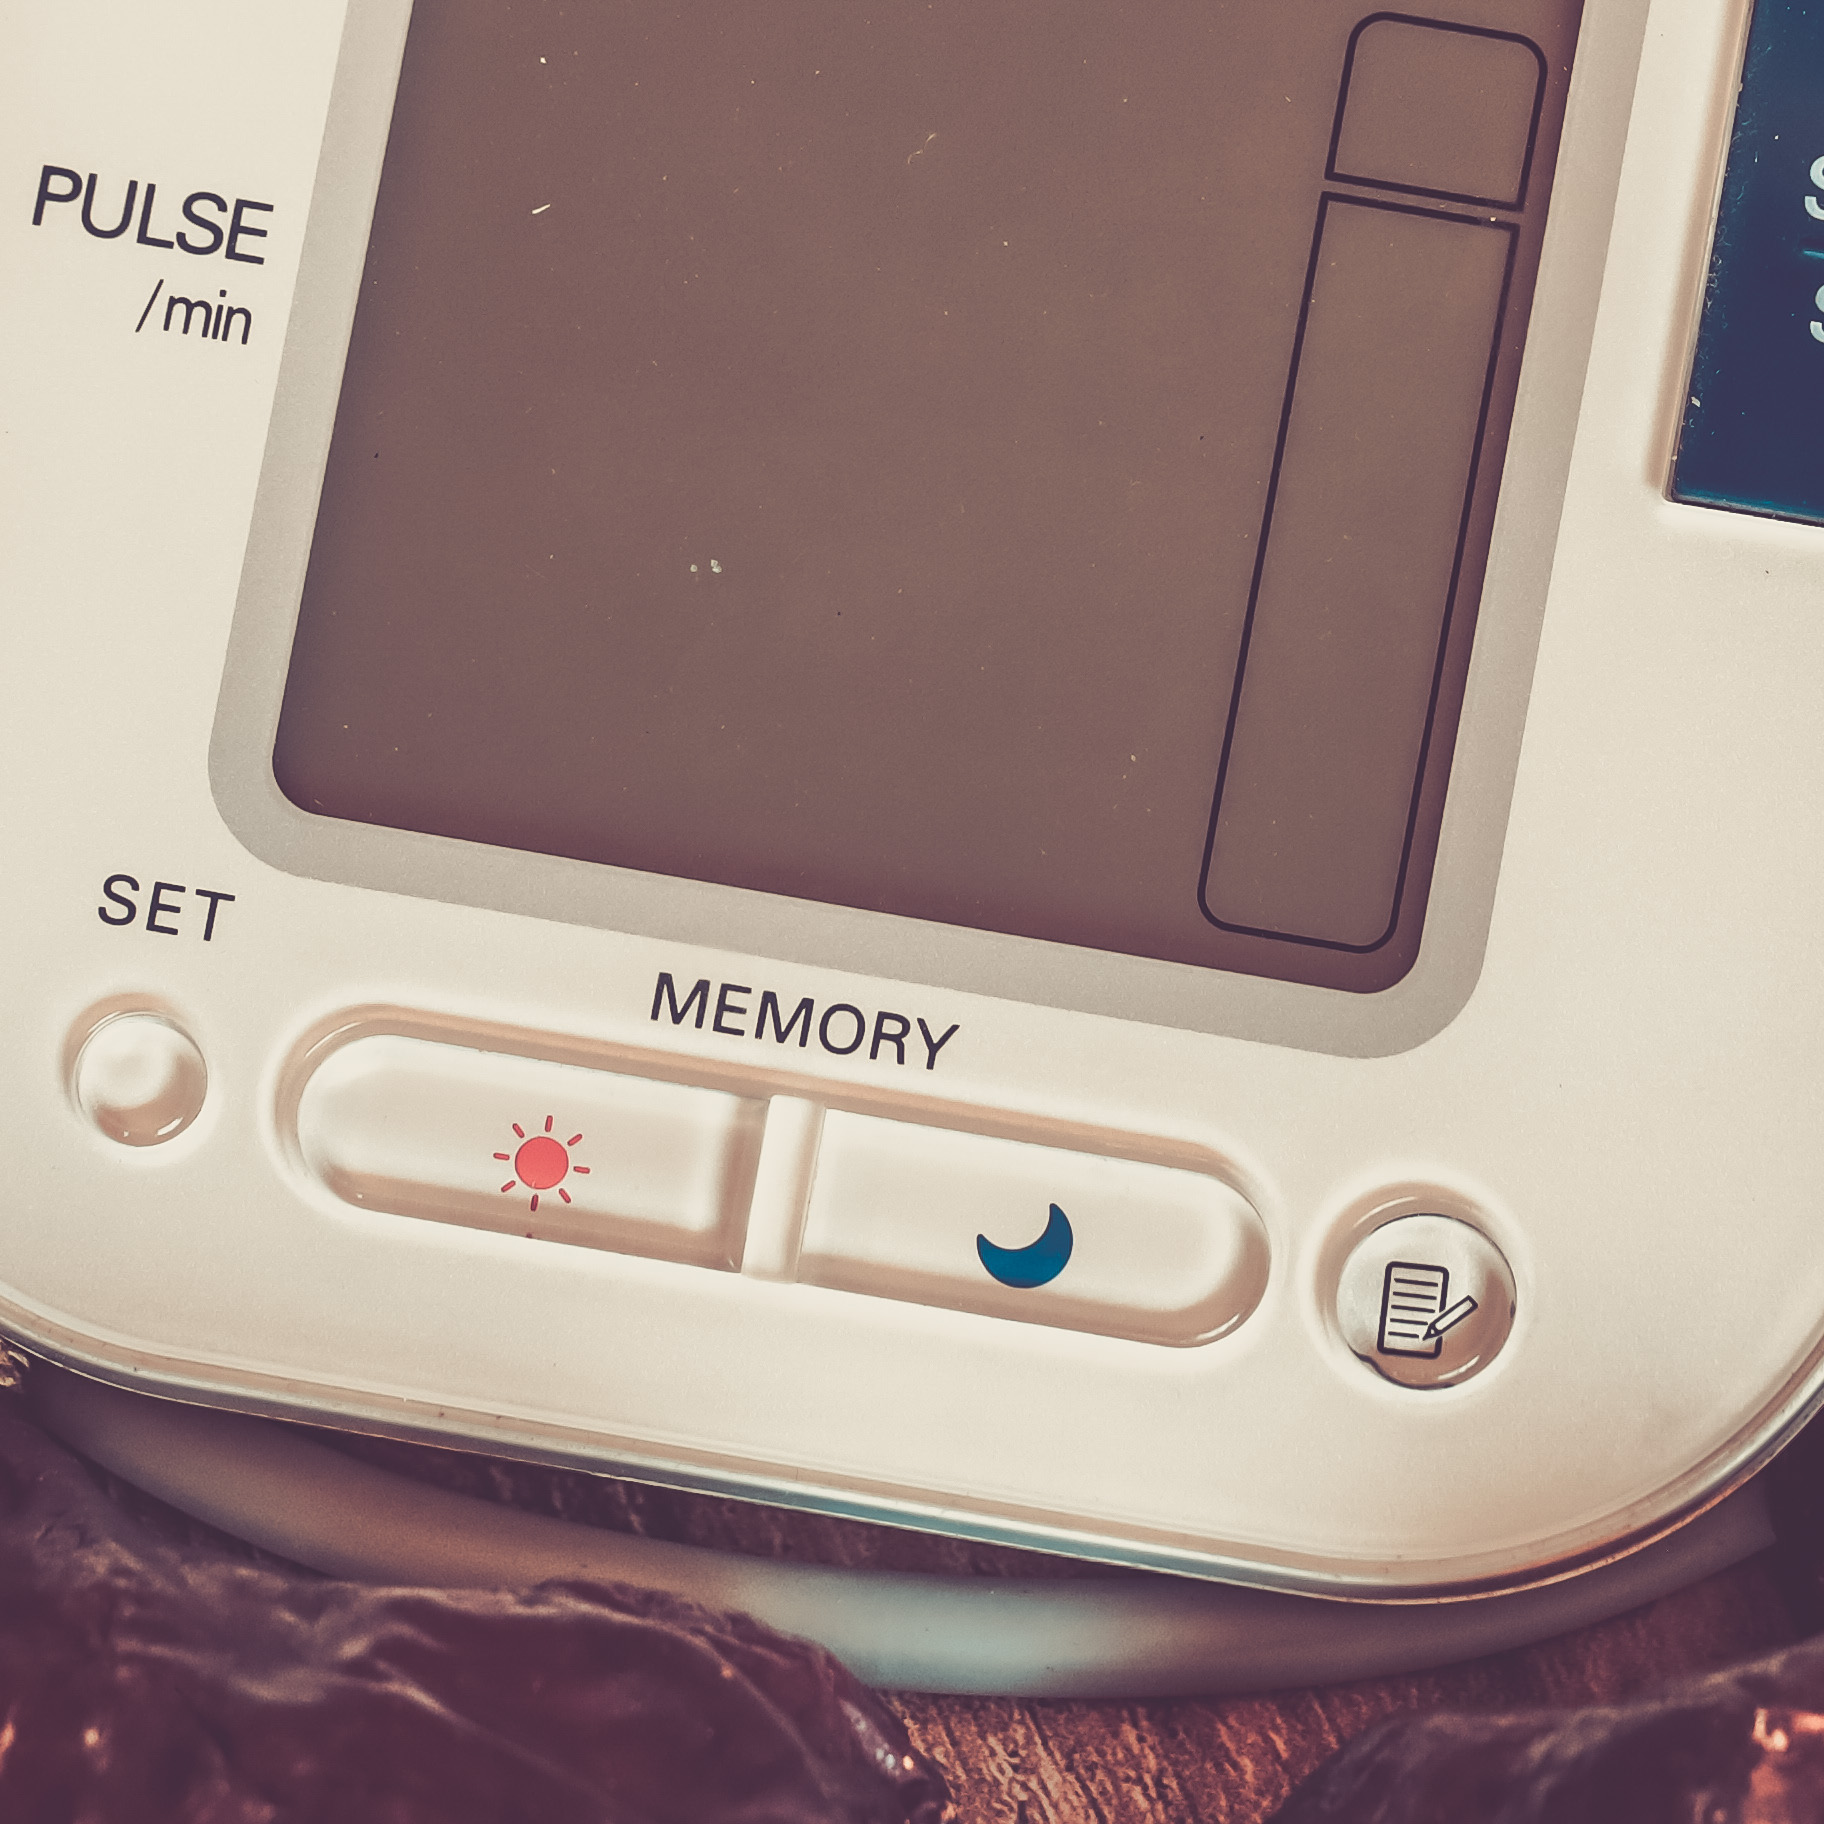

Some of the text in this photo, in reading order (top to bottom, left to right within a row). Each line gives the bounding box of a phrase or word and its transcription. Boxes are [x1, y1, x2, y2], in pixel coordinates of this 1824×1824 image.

[32, 164, 274, 265] PULSE
[135, 279, 252, 345] /min
[97, 873, 236, 942] SET
[649, 971, 961, 1071] MEMORY
